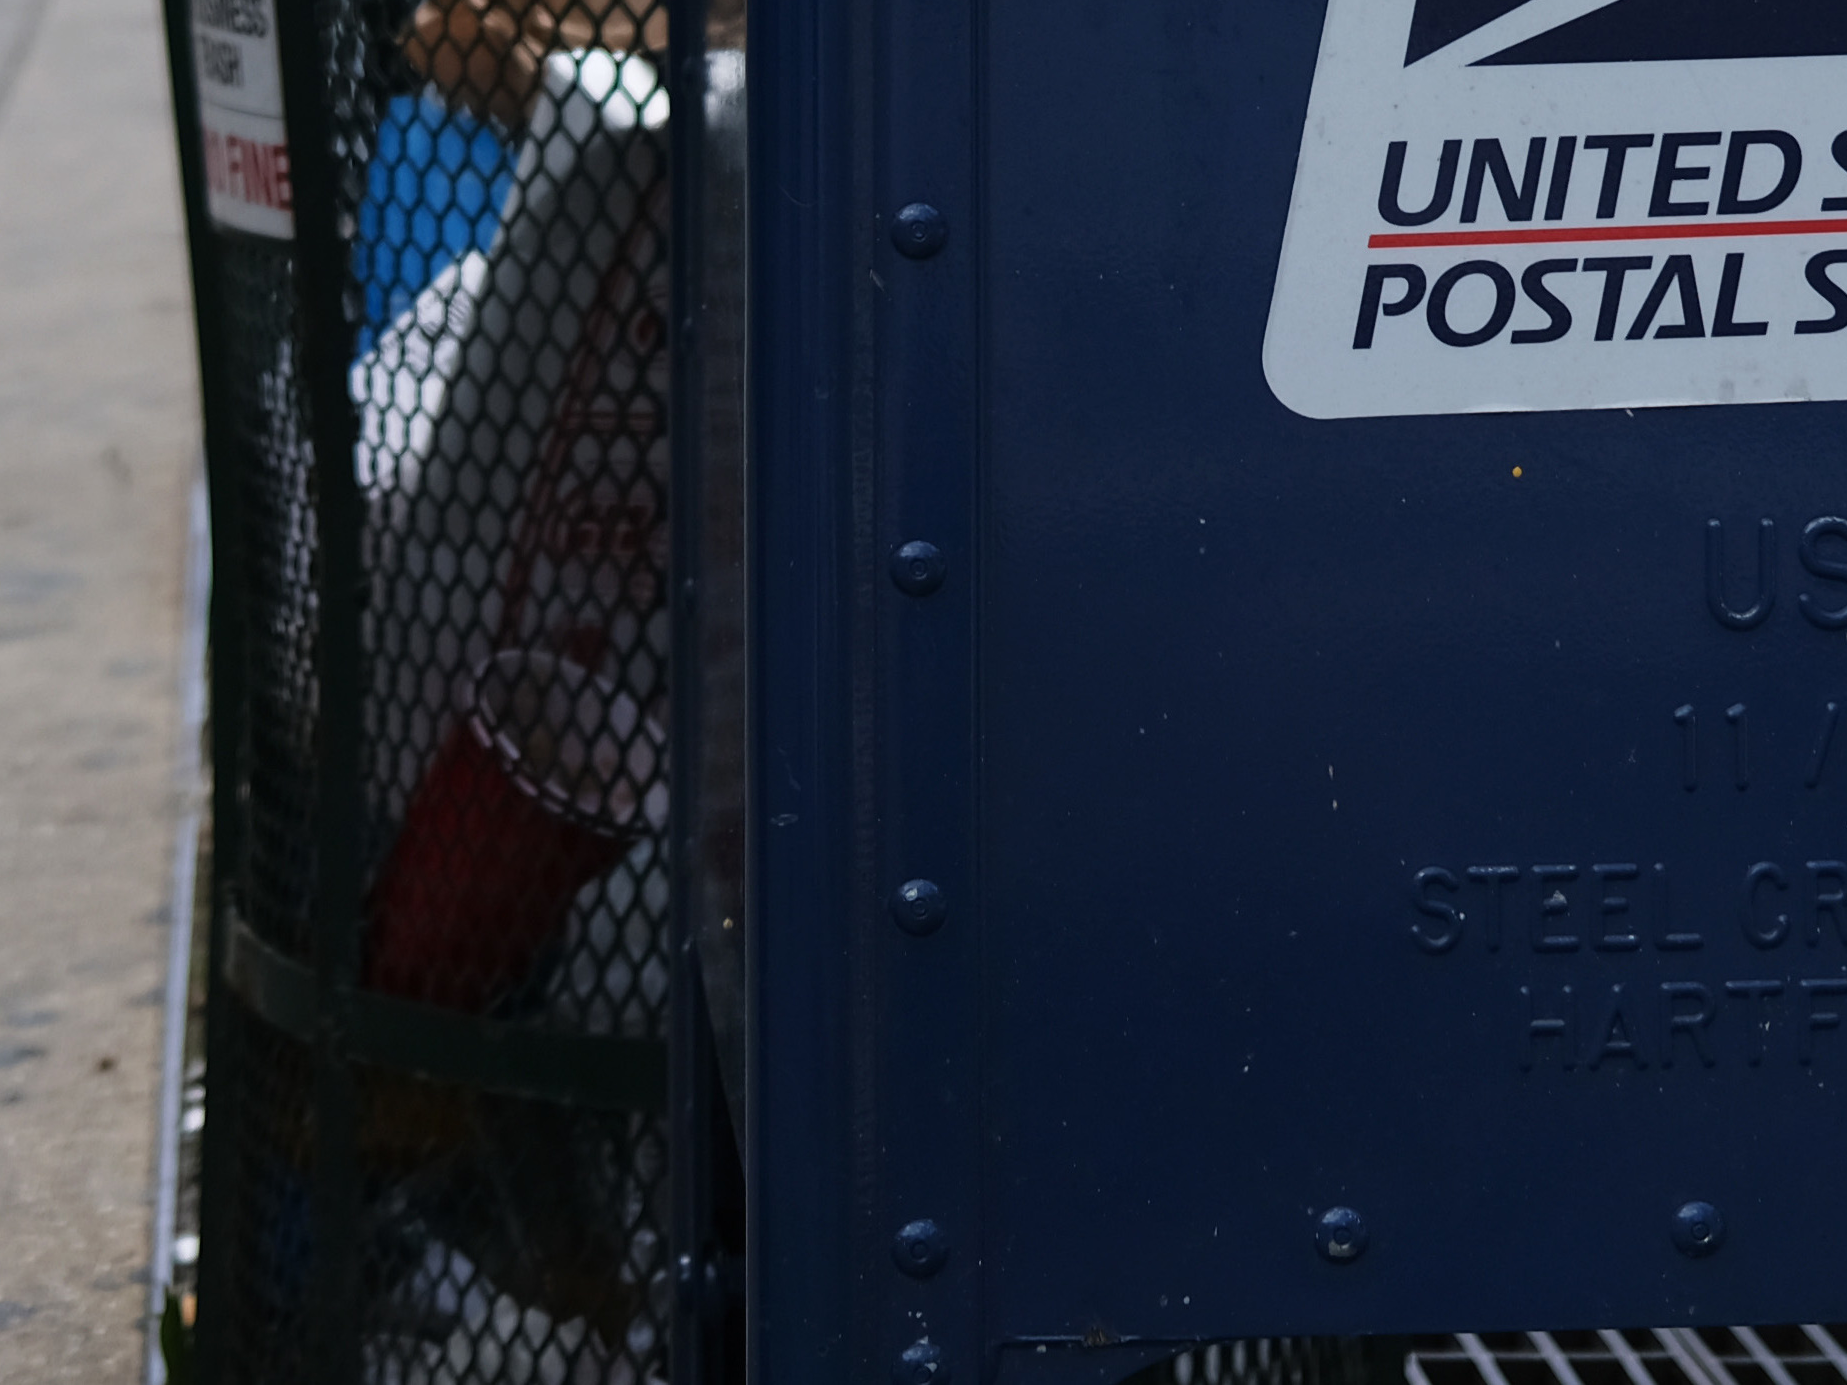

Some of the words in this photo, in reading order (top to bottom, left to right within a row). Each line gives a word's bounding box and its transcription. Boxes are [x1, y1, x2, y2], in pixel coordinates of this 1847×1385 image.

[1375, 128, 1802, 227] UNITED
[1352, 251, 1769, 351] POSTAL
[1409, 862, 1704, 955] STEEL
